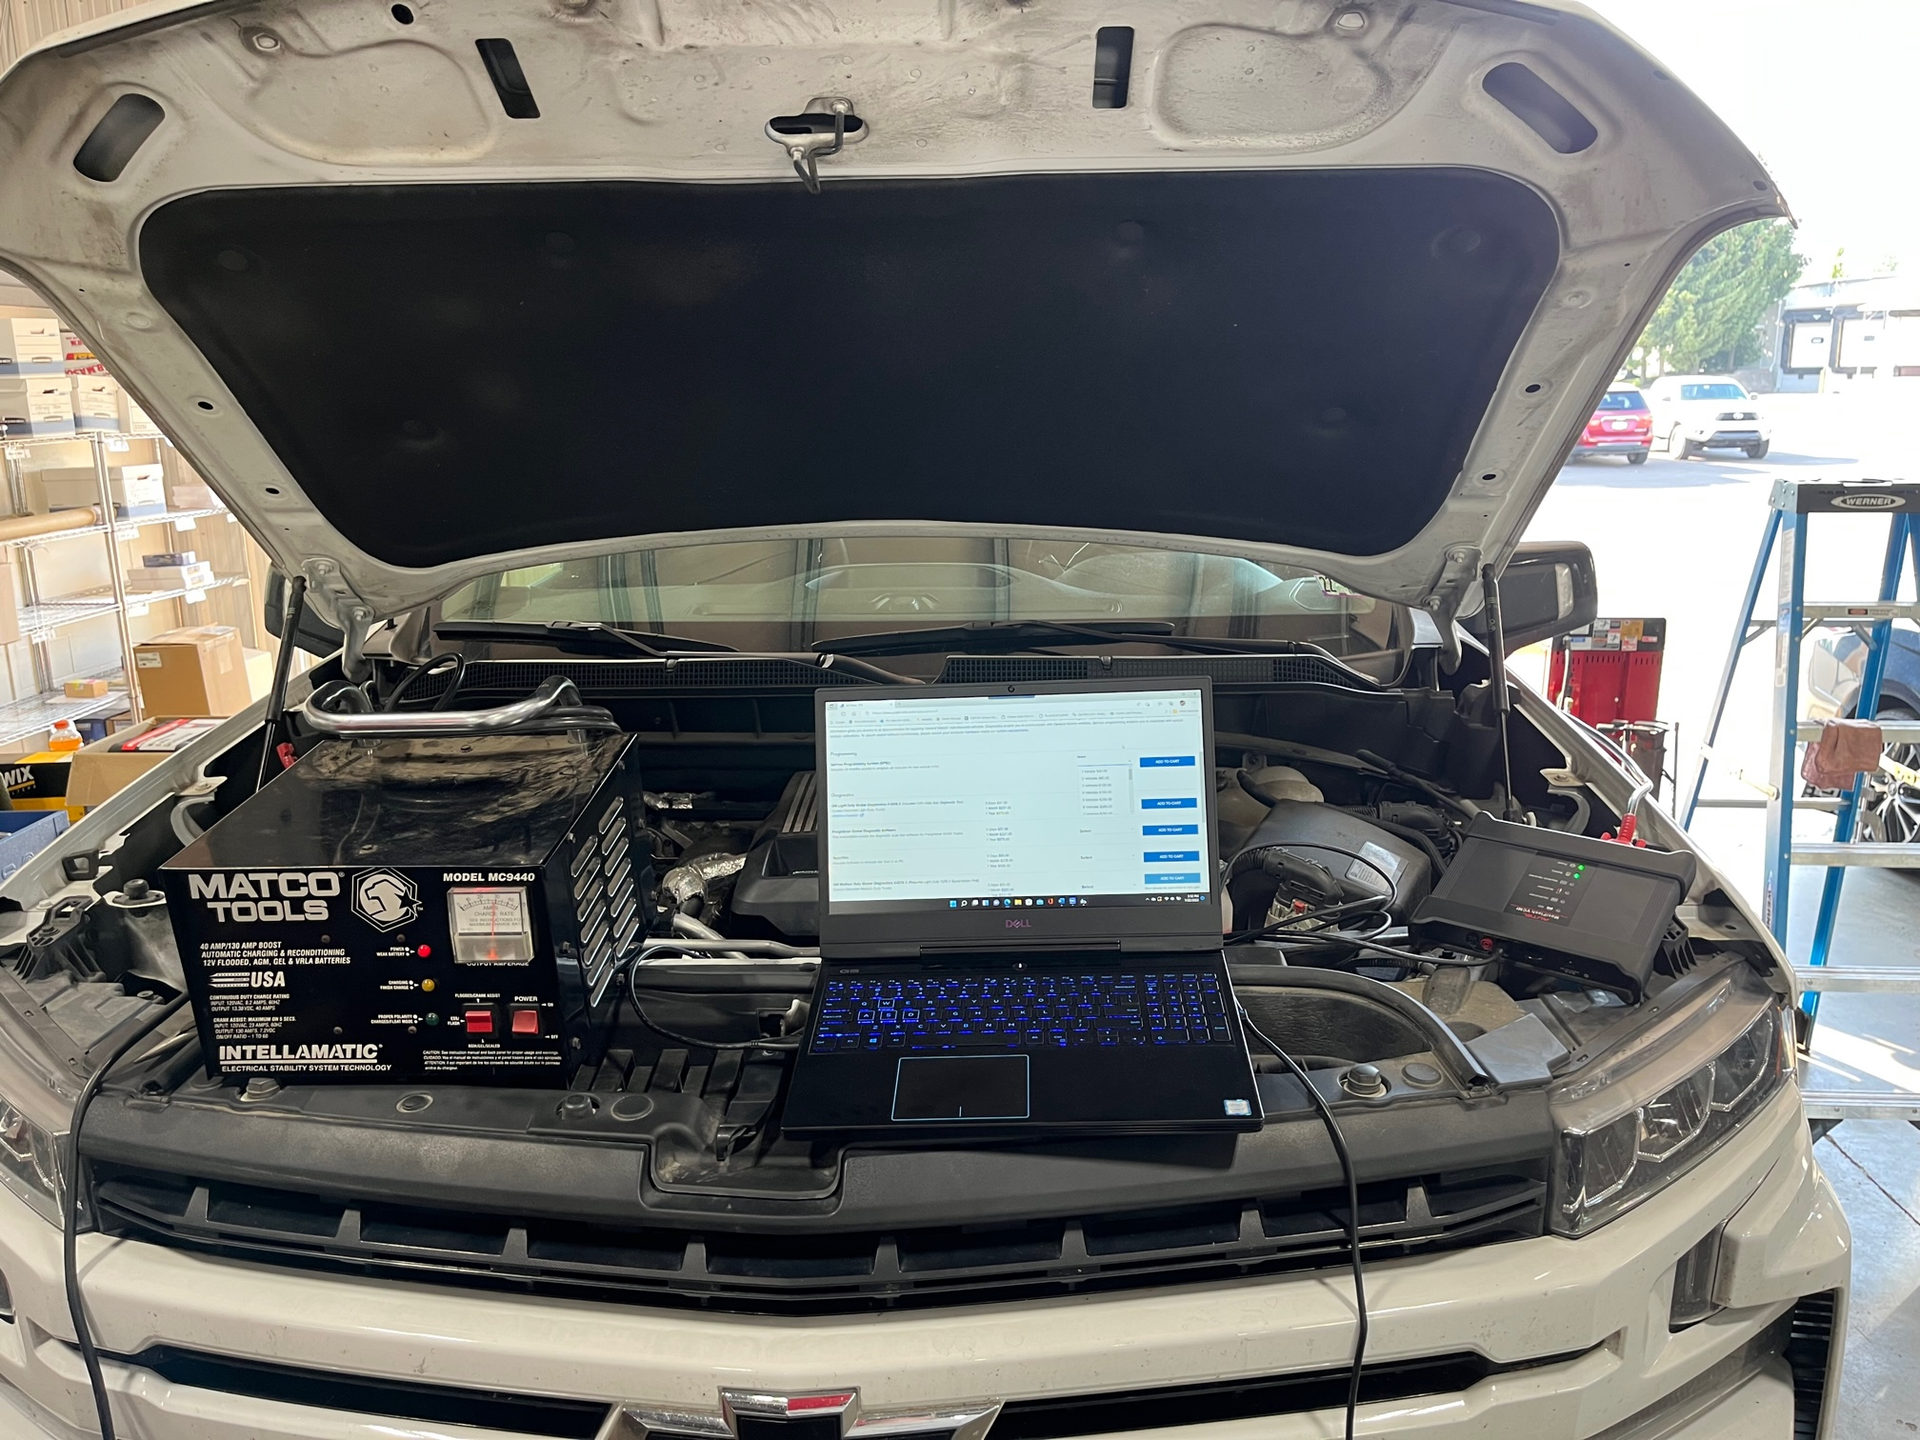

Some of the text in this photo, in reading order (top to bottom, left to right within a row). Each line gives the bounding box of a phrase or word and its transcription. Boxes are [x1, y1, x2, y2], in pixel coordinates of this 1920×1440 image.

[0, 765, 34, 788] WIX
[443, 872, 535, 881] MODEL MC9440
[188, 872, 340, 899] MATCO
[207, 900, 329, 923] TOOLS
[1005, 919, 1032, 928] DELL
[250, 971, 285, 987] USA
[219, 1044, 378, 1060] INTELLAMATIC
